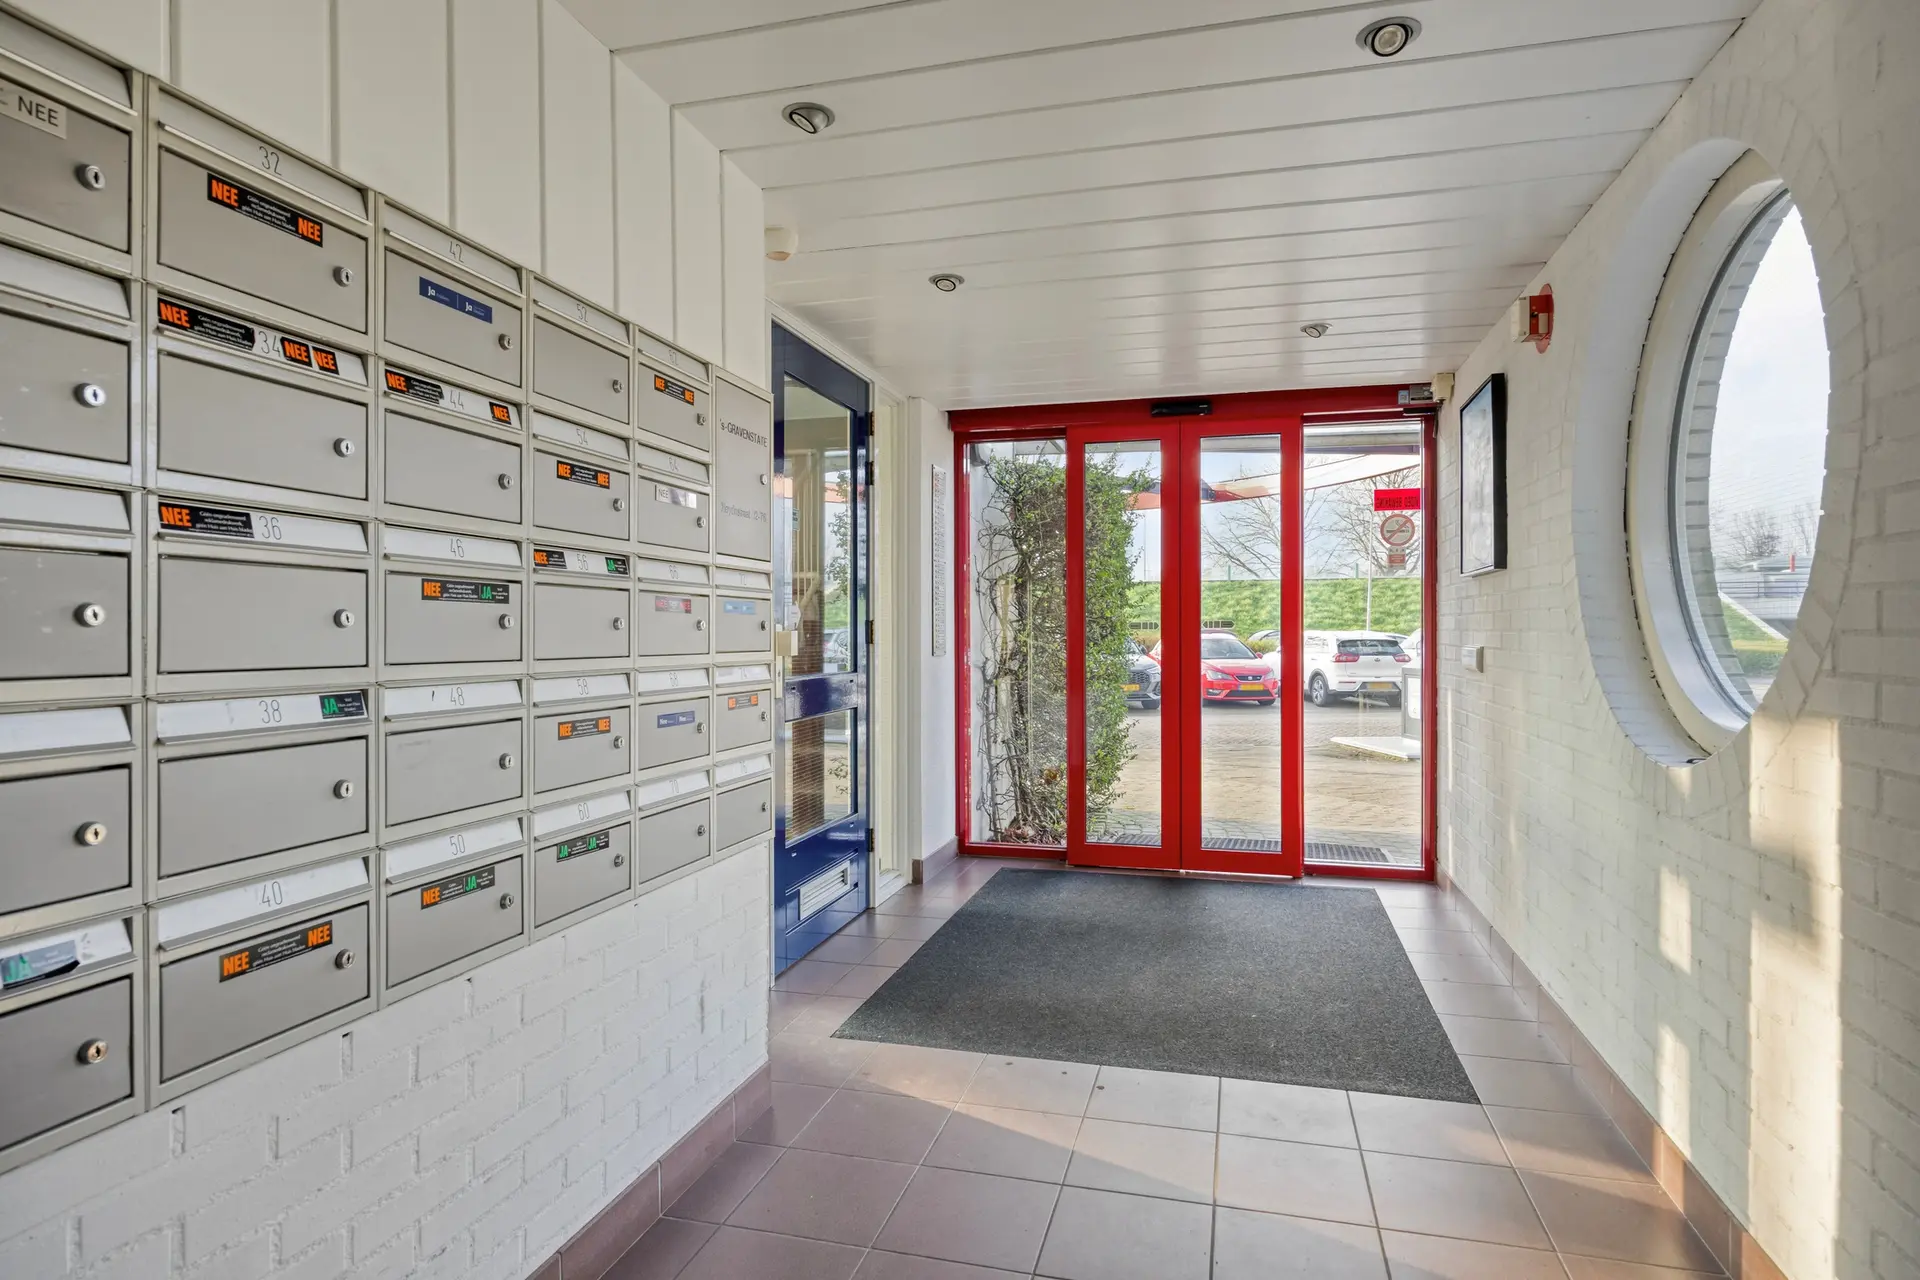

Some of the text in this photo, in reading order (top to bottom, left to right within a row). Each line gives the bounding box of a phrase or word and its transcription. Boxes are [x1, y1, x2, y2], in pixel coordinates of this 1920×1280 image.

[18, 95, 59, 127] NEE
[259, 146, 281, 176] 32
[211, 179, 239, 208] NEE
[298, 217, 321, 242] NEE
[449, 241, 464, 263] 42
[428, 286, 436, 296] Ja
[159, 302, 191, 328] NEE
[465, 302, 473, 312] Ja
[577, 303, 588, 322] 52
[258, 330, 281, 358] 34
[284, 340, 309, 362] NEE
[312, 350, 336, 371] NEE
[386, 372, 408, 393] NEE
[449, 389, 465, 410] 44
[492, 405, 509, 422] NEE
[576, 428, 589, 446] 54
[558, 463, 571, 478] NEE
[597, 472, 609, 486] NEE
[658, 488, 668, 499] NEE
[160, 505, 192, 527] NEE
[259, 515, 282, 540] 36
[449, 537, 464, 558] 46
[534, 551, 549, 565] NEE
[576, 553, 588, 571] 56
[607, 559, 616, 571] JA
[423, 582, 441, 597] NEE
[481, 586, 493, 600] JA
[450, 686, 464, 706] 48
[577, 678, 589, 696] 58
[259, 699, 282, 724] 38
[323, 698, 339, 715] JA
[559, 723, 572, 737] NEE
[598, 718, 610, 731] NEE
[669, 779, 680, 794] 70
[578, 802, 590, 820] 60
[449, 834, 465, 856] 50
[559, 845, 568, 858] JA
[588, 836, 597, 850] JA
[466, 875, 477, 892] JA
[261, 881, 283, 907] 40
[423, 887, 440, 905] NEE
[308, 924, 331, 947] NEE
[4, 955, 32, 982] JA
[223, 951, 249, 976] NEE
